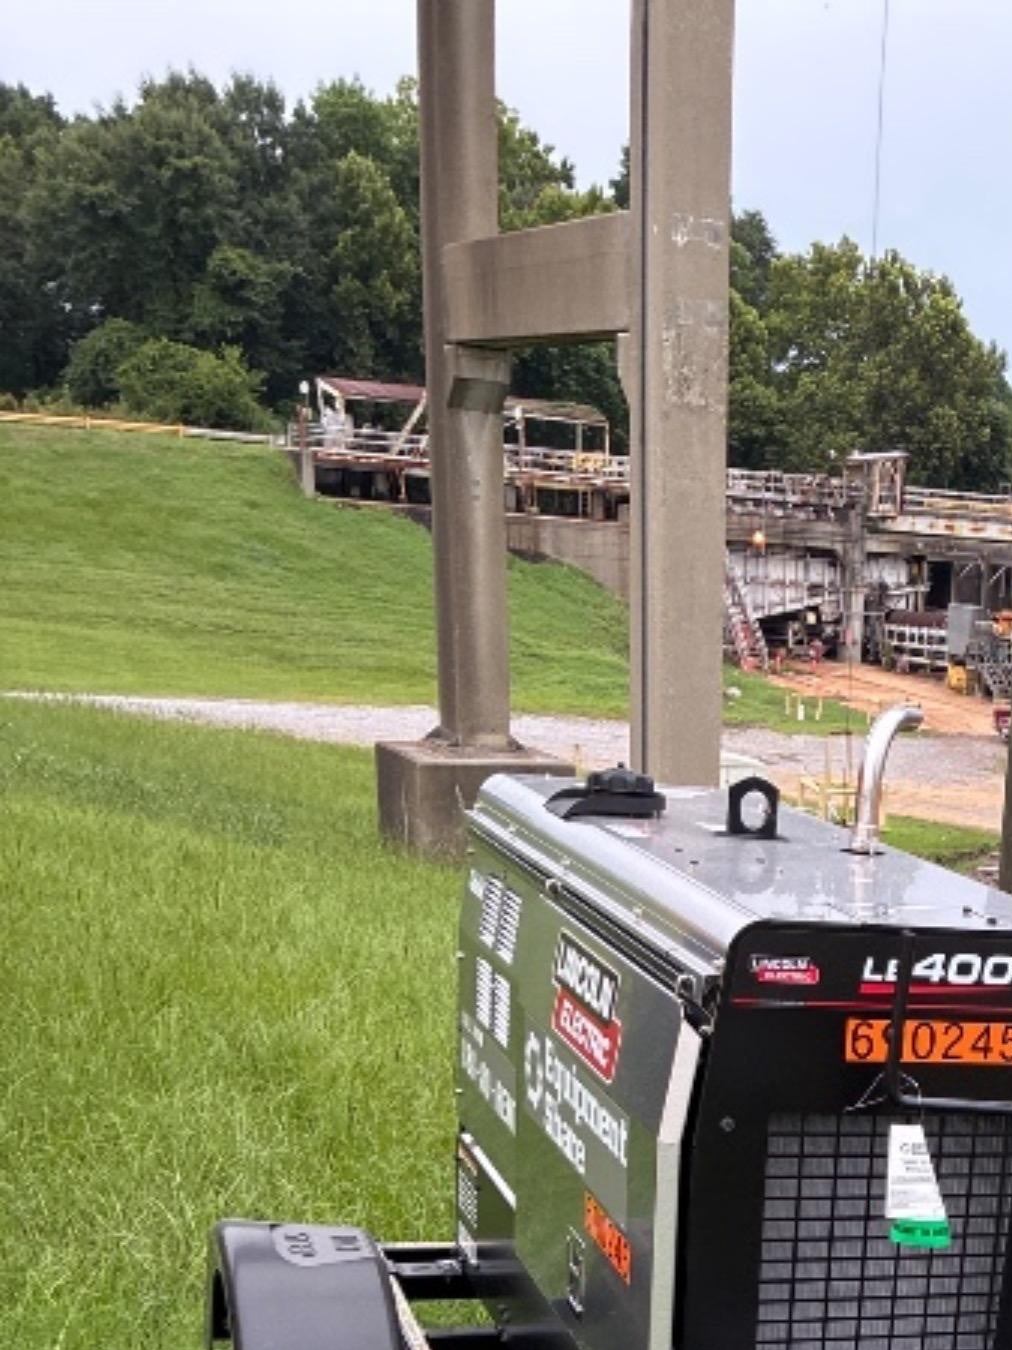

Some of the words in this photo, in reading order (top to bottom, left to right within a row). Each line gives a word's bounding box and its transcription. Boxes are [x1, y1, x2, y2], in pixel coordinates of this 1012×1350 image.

[557, 940, 616, 1021] LINCOLN
[544, 1036, 628, 1169] Equipment
[544, 1090, 586, 1176] Share
